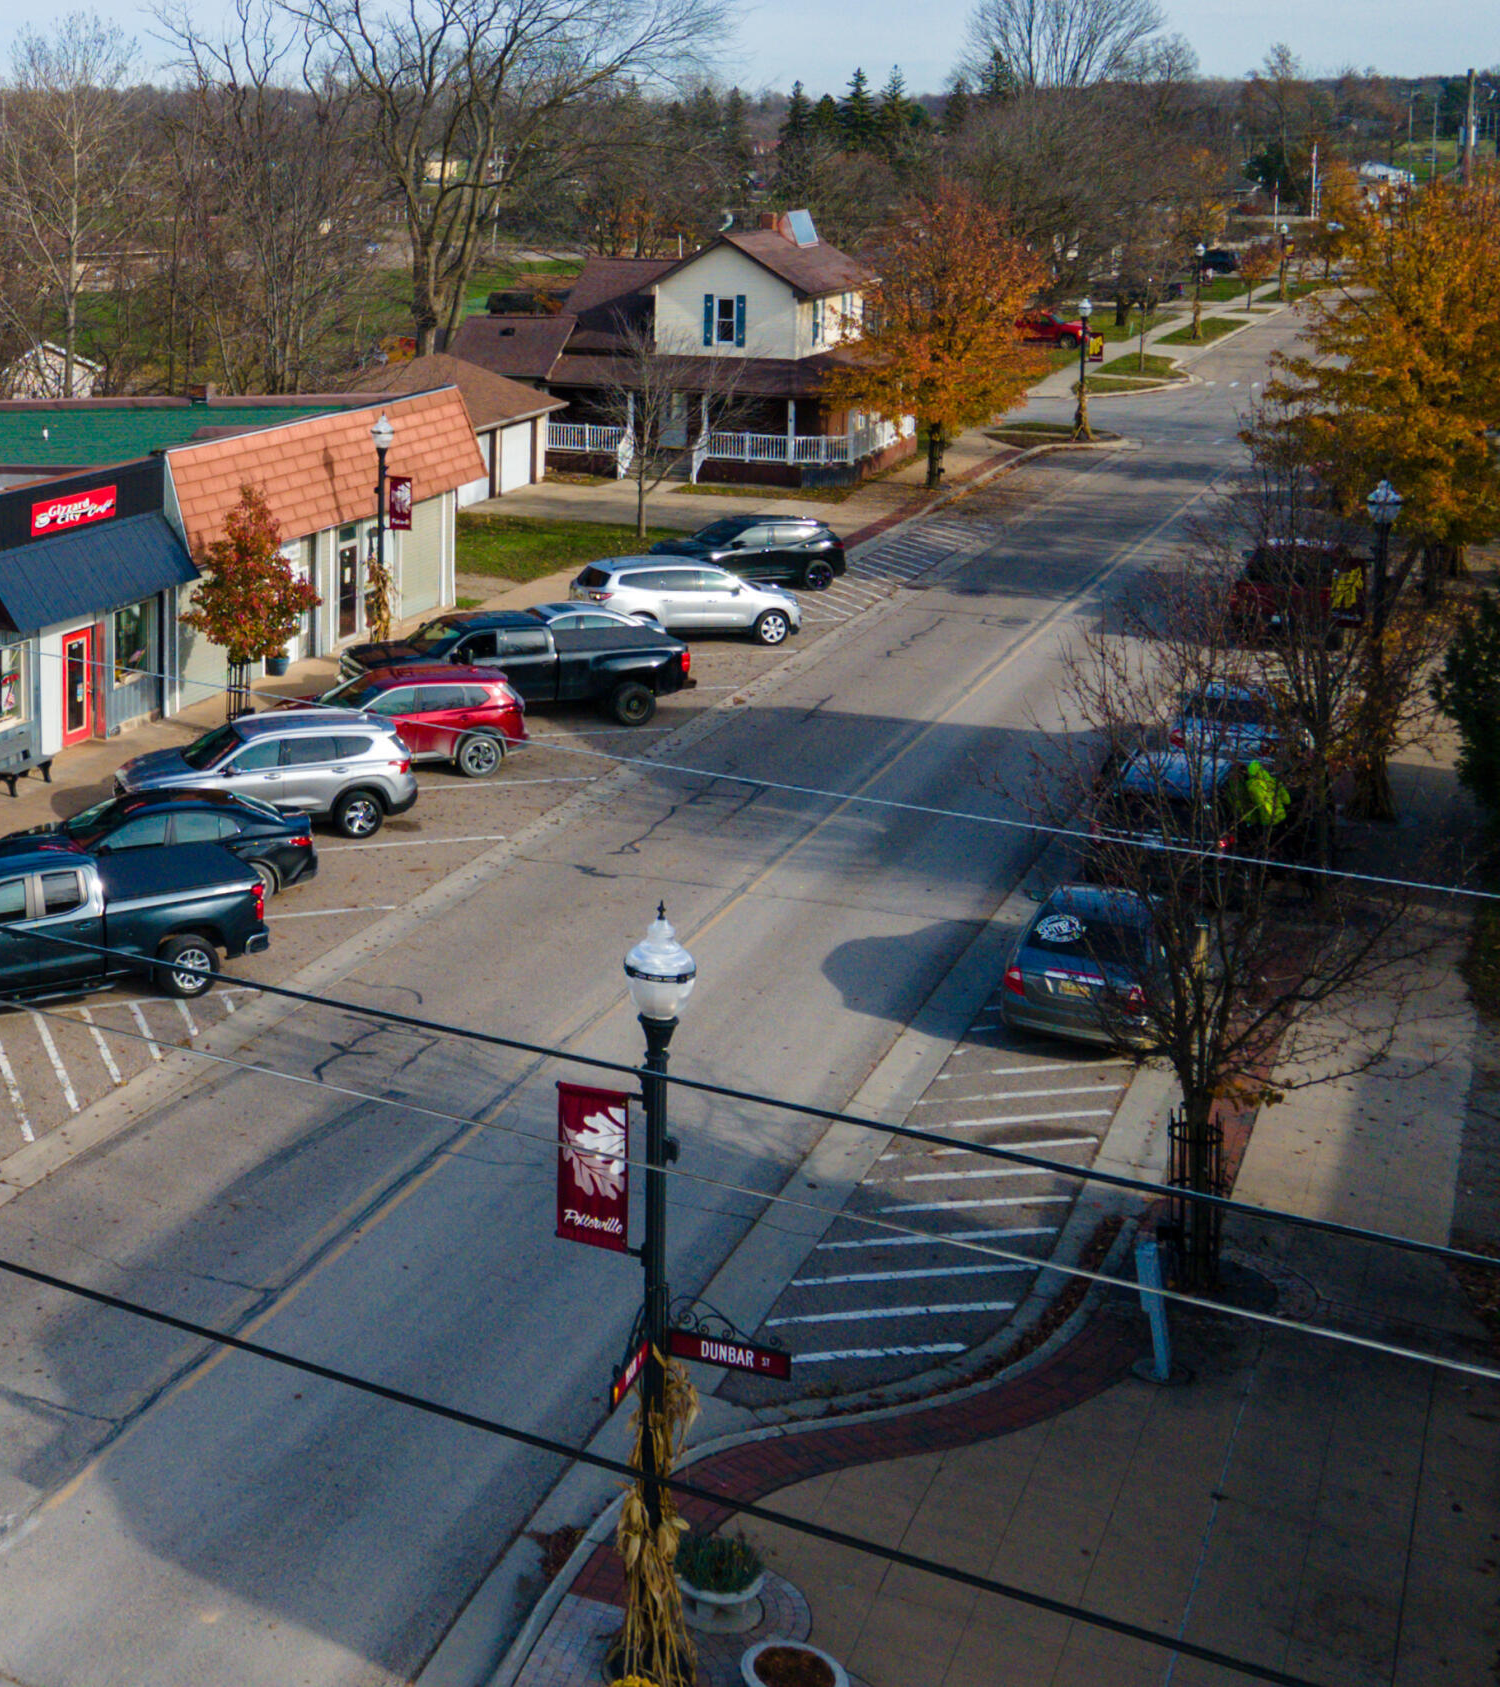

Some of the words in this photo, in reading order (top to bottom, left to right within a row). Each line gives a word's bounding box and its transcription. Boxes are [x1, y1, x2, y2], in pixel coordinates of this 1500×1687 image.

[48, 497, 90, 516] Gizzard
[57, 512, 81, 524] City
[563, 1209, 623, 1235] Potterville
[700, 1340, 755, 1368] DUNBAR
[761, 1356, 771, 1367] ST
